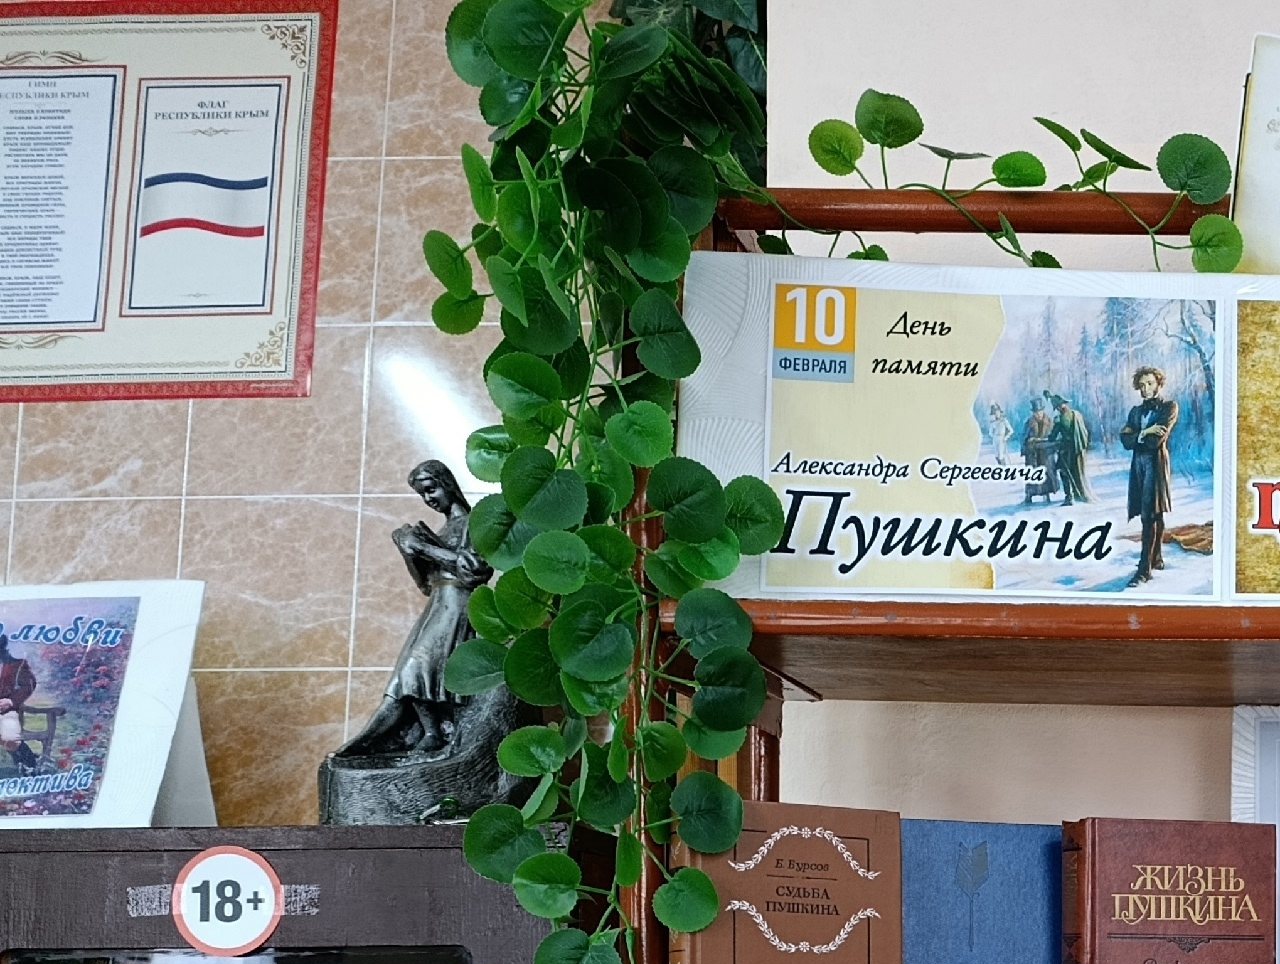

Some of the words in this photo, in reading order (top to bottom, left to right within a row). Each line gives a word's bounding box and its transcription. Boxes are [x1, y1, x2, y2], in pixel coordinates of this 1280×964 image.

[154, 111, 231, 121] РЕСПУБЛИКИ
[234, 109, 270, 119] КРЫМ
[197, 101, 229, 109] ФЛАГ
[785, 287, 847, 347] 10
[886, 311, 953, 338] День
[778, 356, 848, 375] ФЕВРАЛЯ
[871, 356, 980, 379] памяти
[770, 451, 910, 485] Александра
[919, 458, 1046, 486] Сергеевича
[769, 488, 1114, 575] Пушкина
[9, 615, 126, 648] любви
[787, 859, 830, 873] Бурсов
[1130, 864, 1245, 895] ЖИЗНЬ
[190, 879, 266, 923] 18+
[775, 885, 831, 900] СУДЬБА
[764, 901, 841, 917] ПУШКИНА
[1111, 893, 1262, 926] ПУШКИНА
